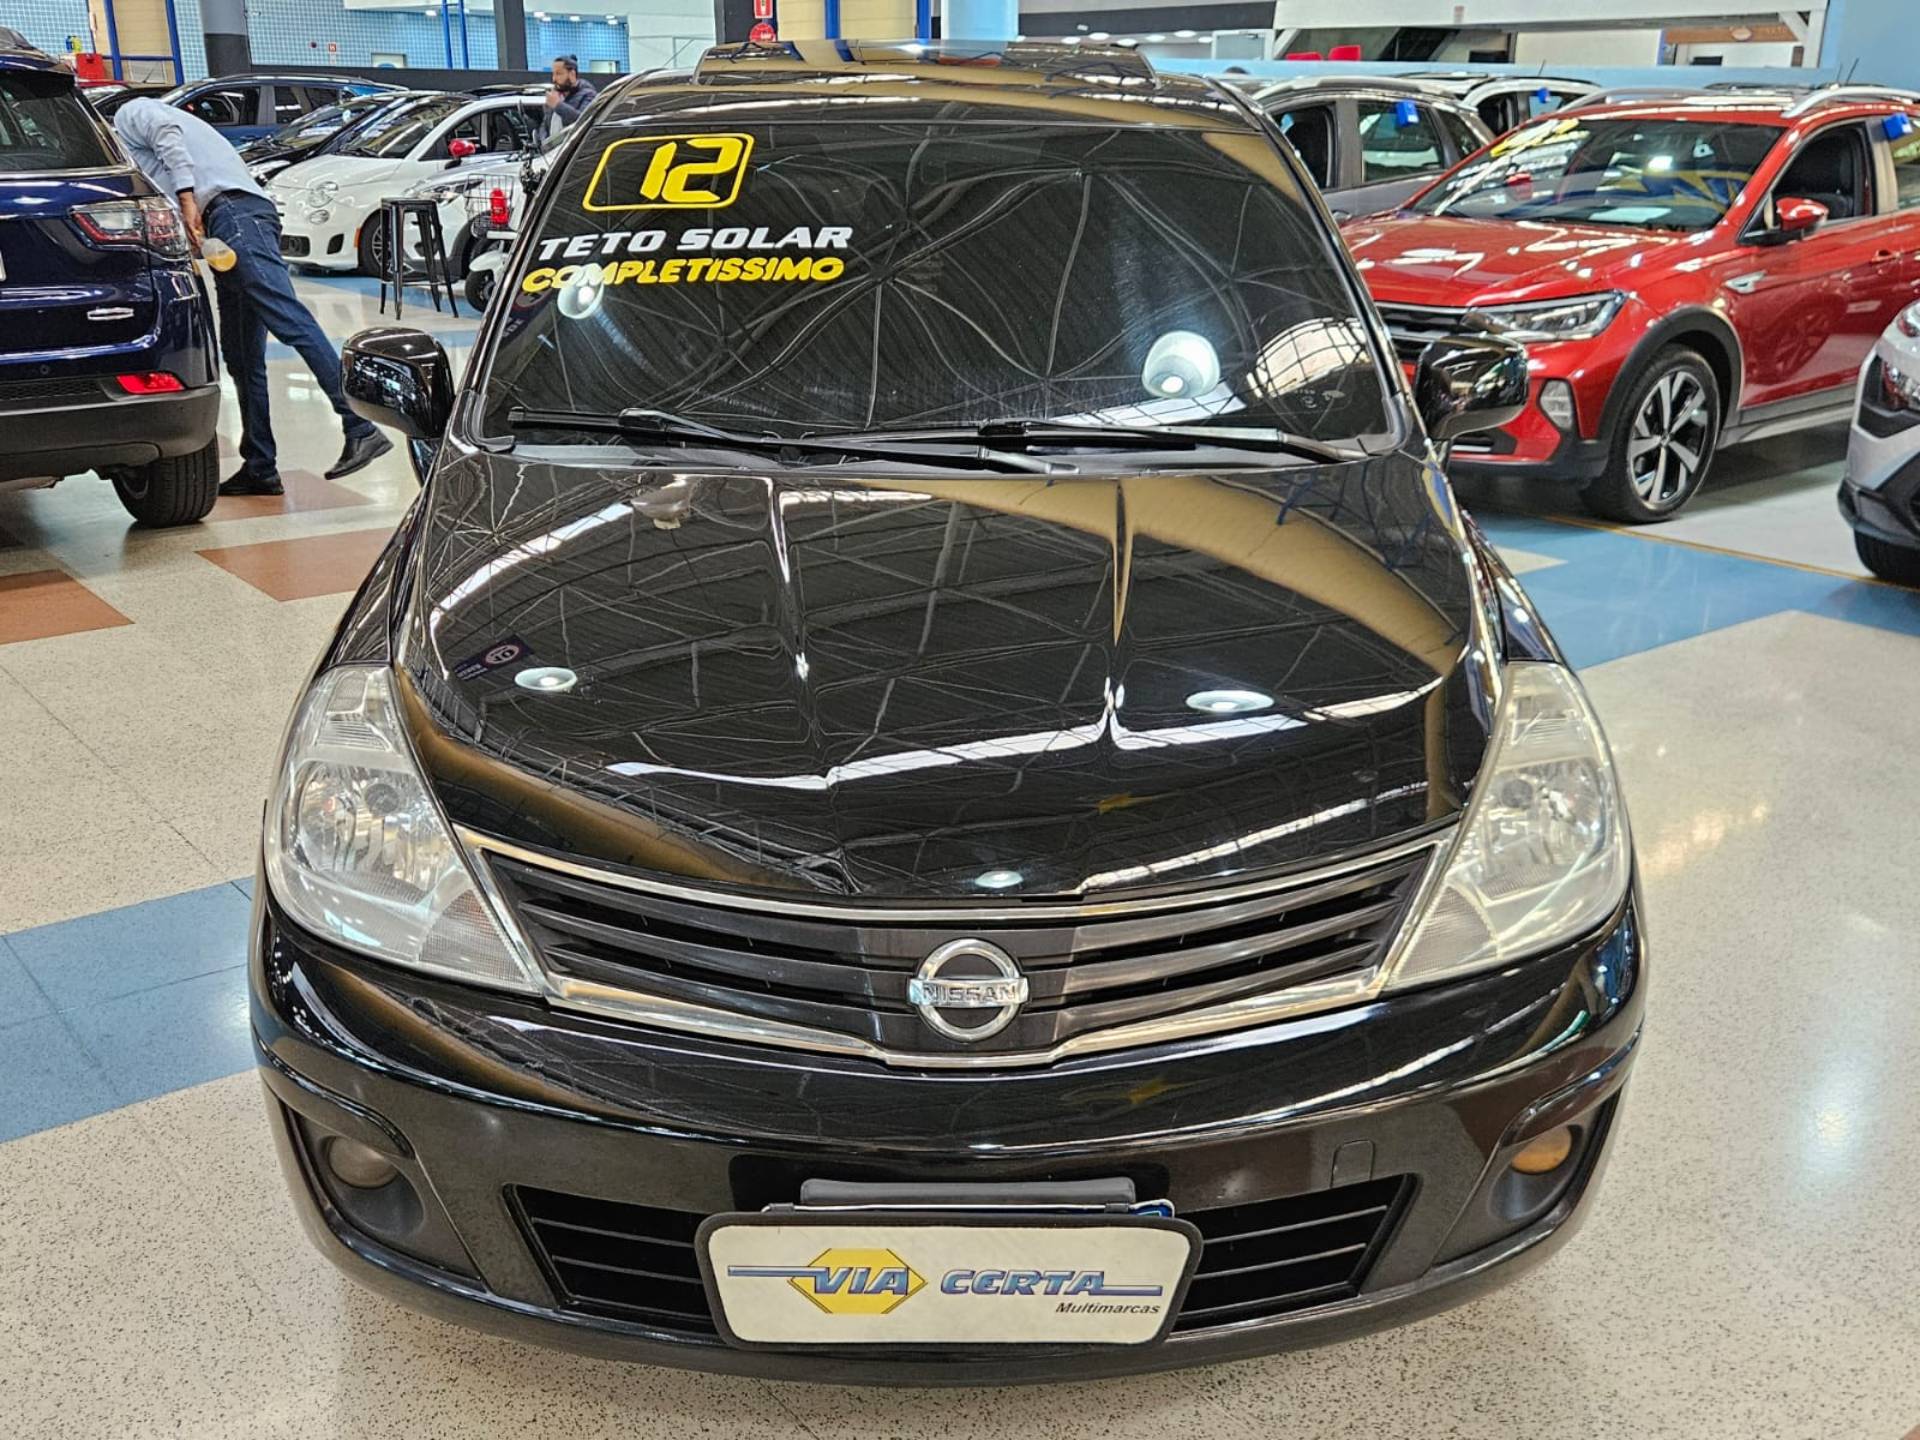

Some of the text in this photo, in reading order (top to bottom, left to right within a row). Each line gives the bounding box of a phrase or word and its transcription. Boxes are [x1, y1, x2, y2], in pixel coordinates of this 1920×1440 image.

[640, 138, 743, 202] 12
[539, 227, 853, 260] TETO SOLAR
[522, 257, 845, 293] COMPLETISSIMO
[923, 984, 1016, 1001] NISSAN
[814, 1266, 1104, 1296] VIA CERTA
[1055, 1301, 1161, 1315] Multimarcas
